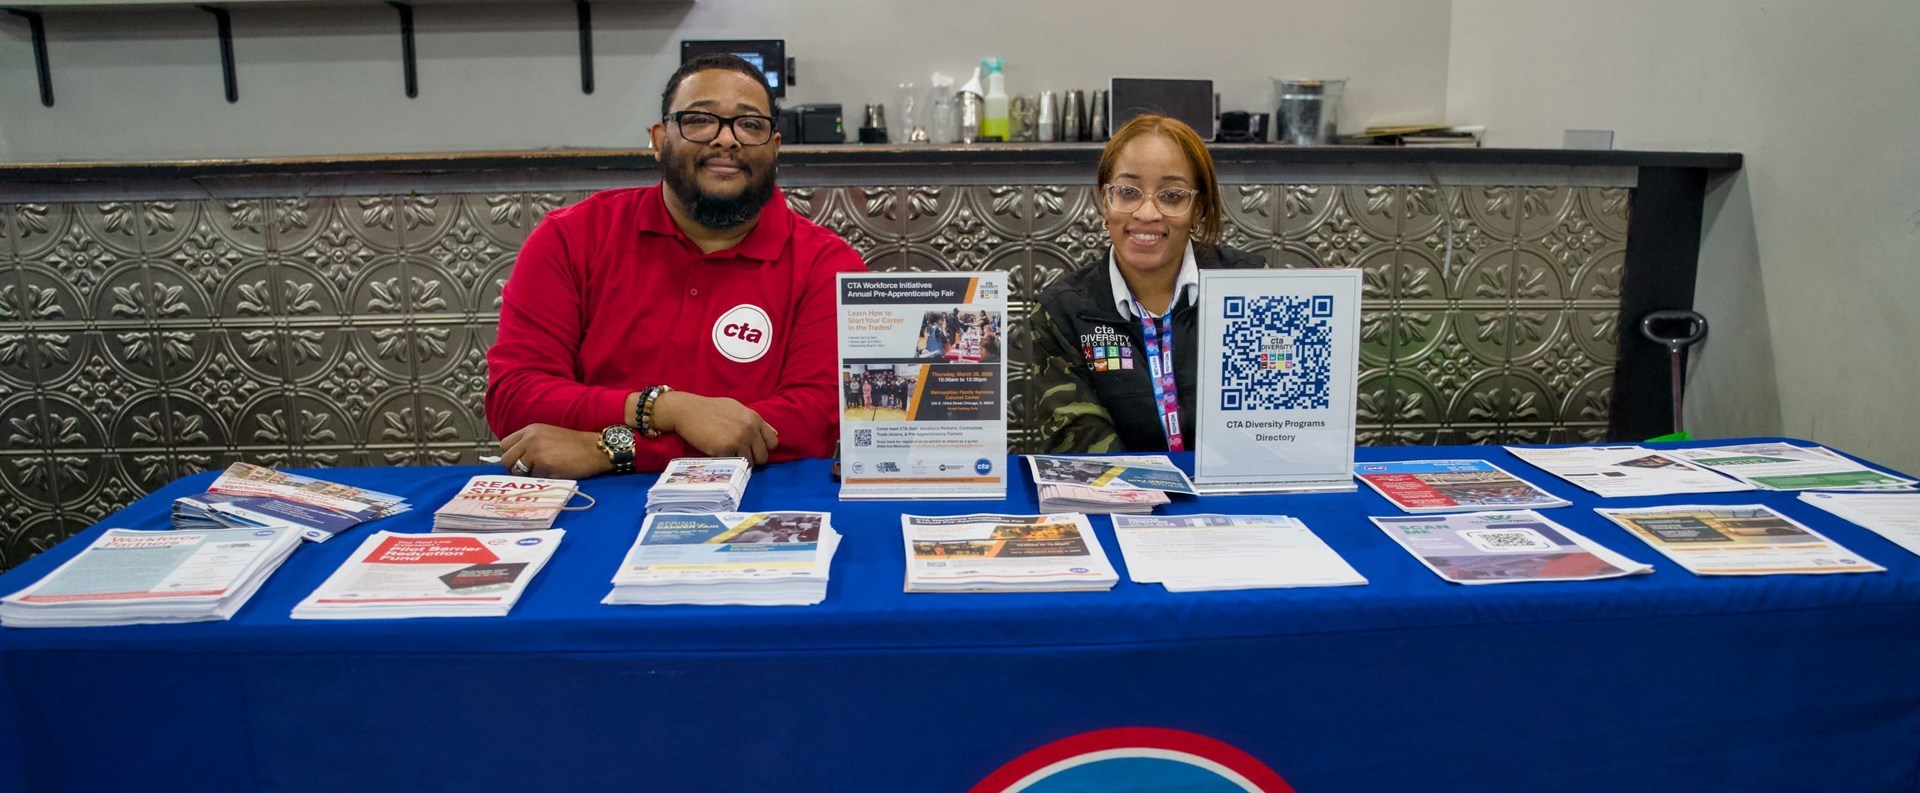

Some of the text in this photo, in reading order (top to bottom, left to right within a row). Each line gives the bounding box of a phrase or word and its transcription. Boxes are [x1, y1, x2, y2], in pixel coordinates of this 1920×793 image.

[863, 281, 898, 289] Workforce
[899, 281, 932, 289] Initiatives
[847, 290, 872, 298] Annual
[873, 290, 940, 299] Pre-Apprenticeship
[723, 322, 763, 344] cta
[1095, 325, 1115, 334] cta
[1080, 334, 1130, 343] DIVERSITY
[1226, 420, 1325, 429] CTA Diversity Programs
[1255, 434, 1296, 442] Directory
[473, 481, 551, 490] READY
[111, 535, 201, 543] Workforce
